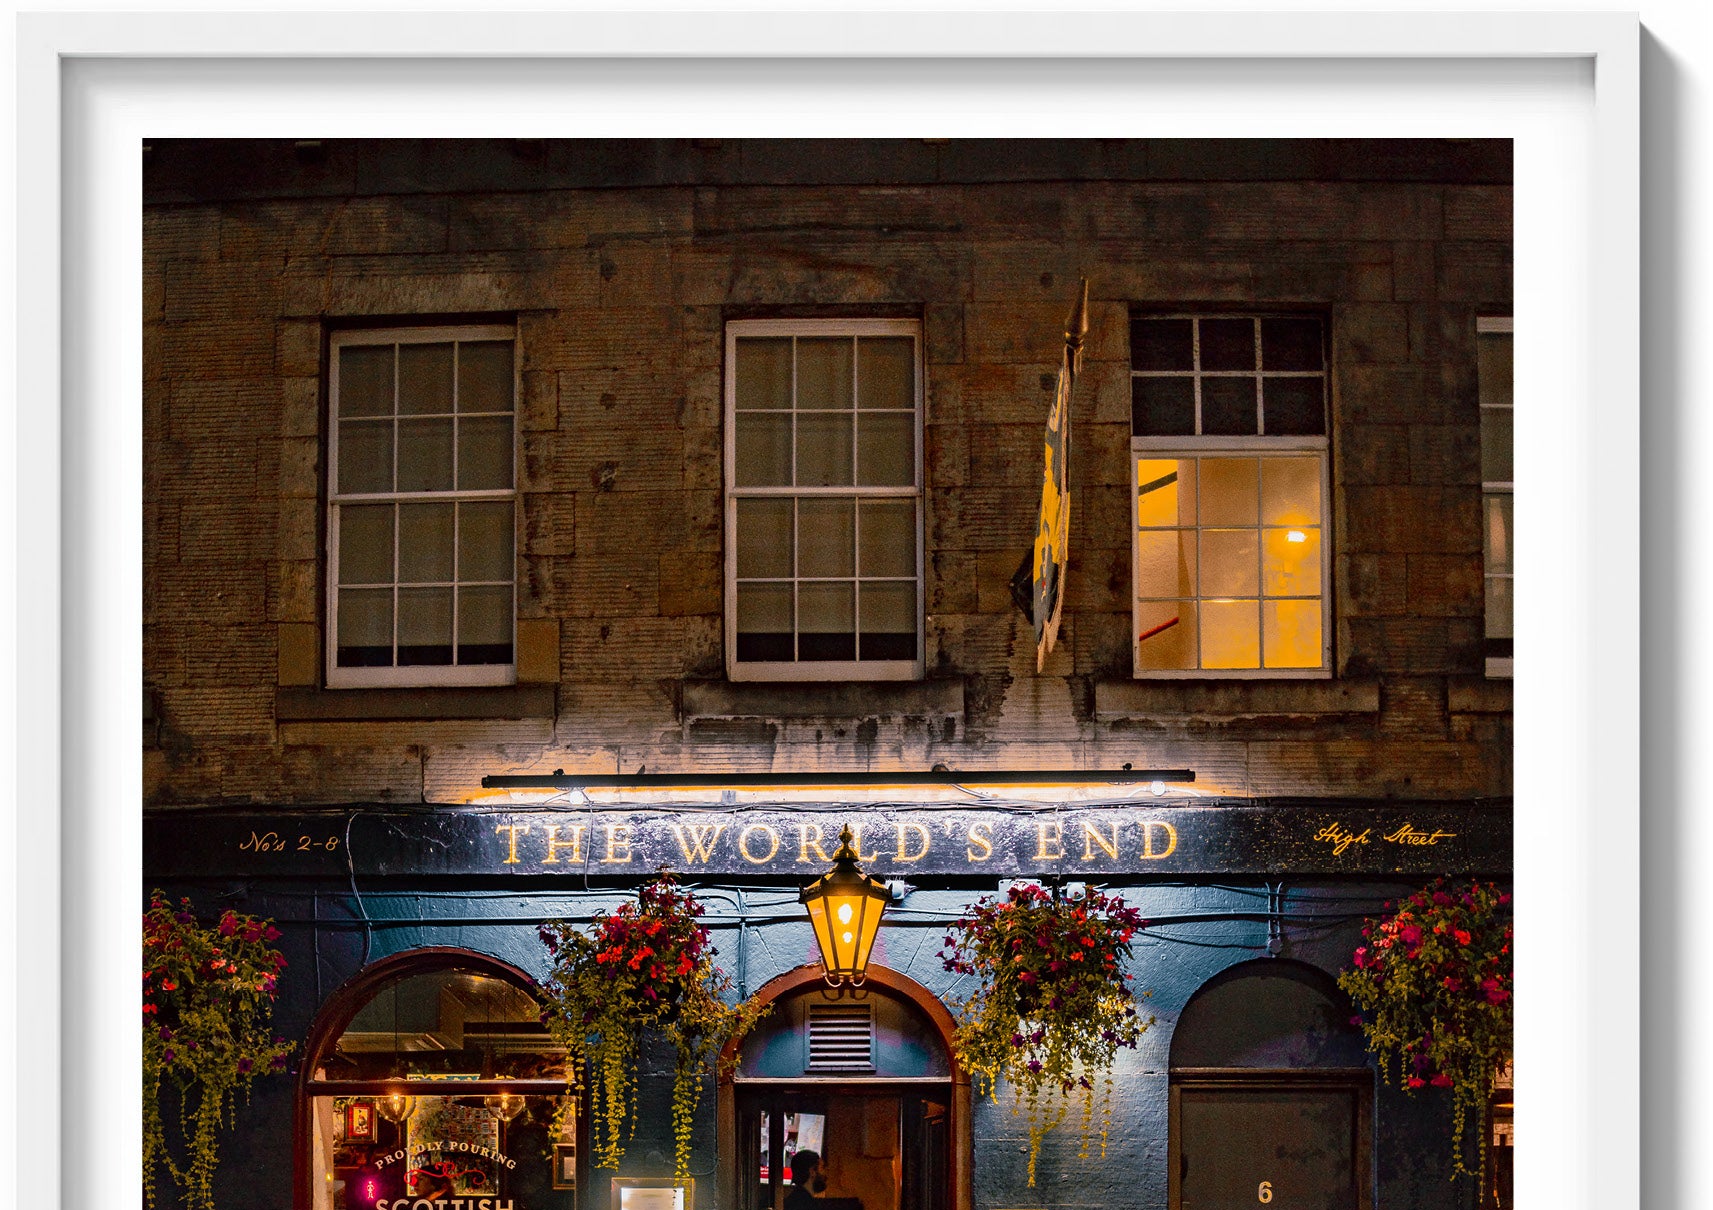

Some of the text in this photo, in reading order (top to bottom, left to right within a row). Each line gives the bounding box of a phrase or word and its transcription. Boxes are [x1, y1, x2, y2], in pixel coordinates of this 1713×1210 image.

[240, 831, 339, 852] No's 2-8
[495, 820, 1178, 865] THE WORLD'S END
[1313, 822, 1457, 856] High Street
[450, 1141, 517, 1170] POURING
[1258, 1181, 1273, 1204] 6
